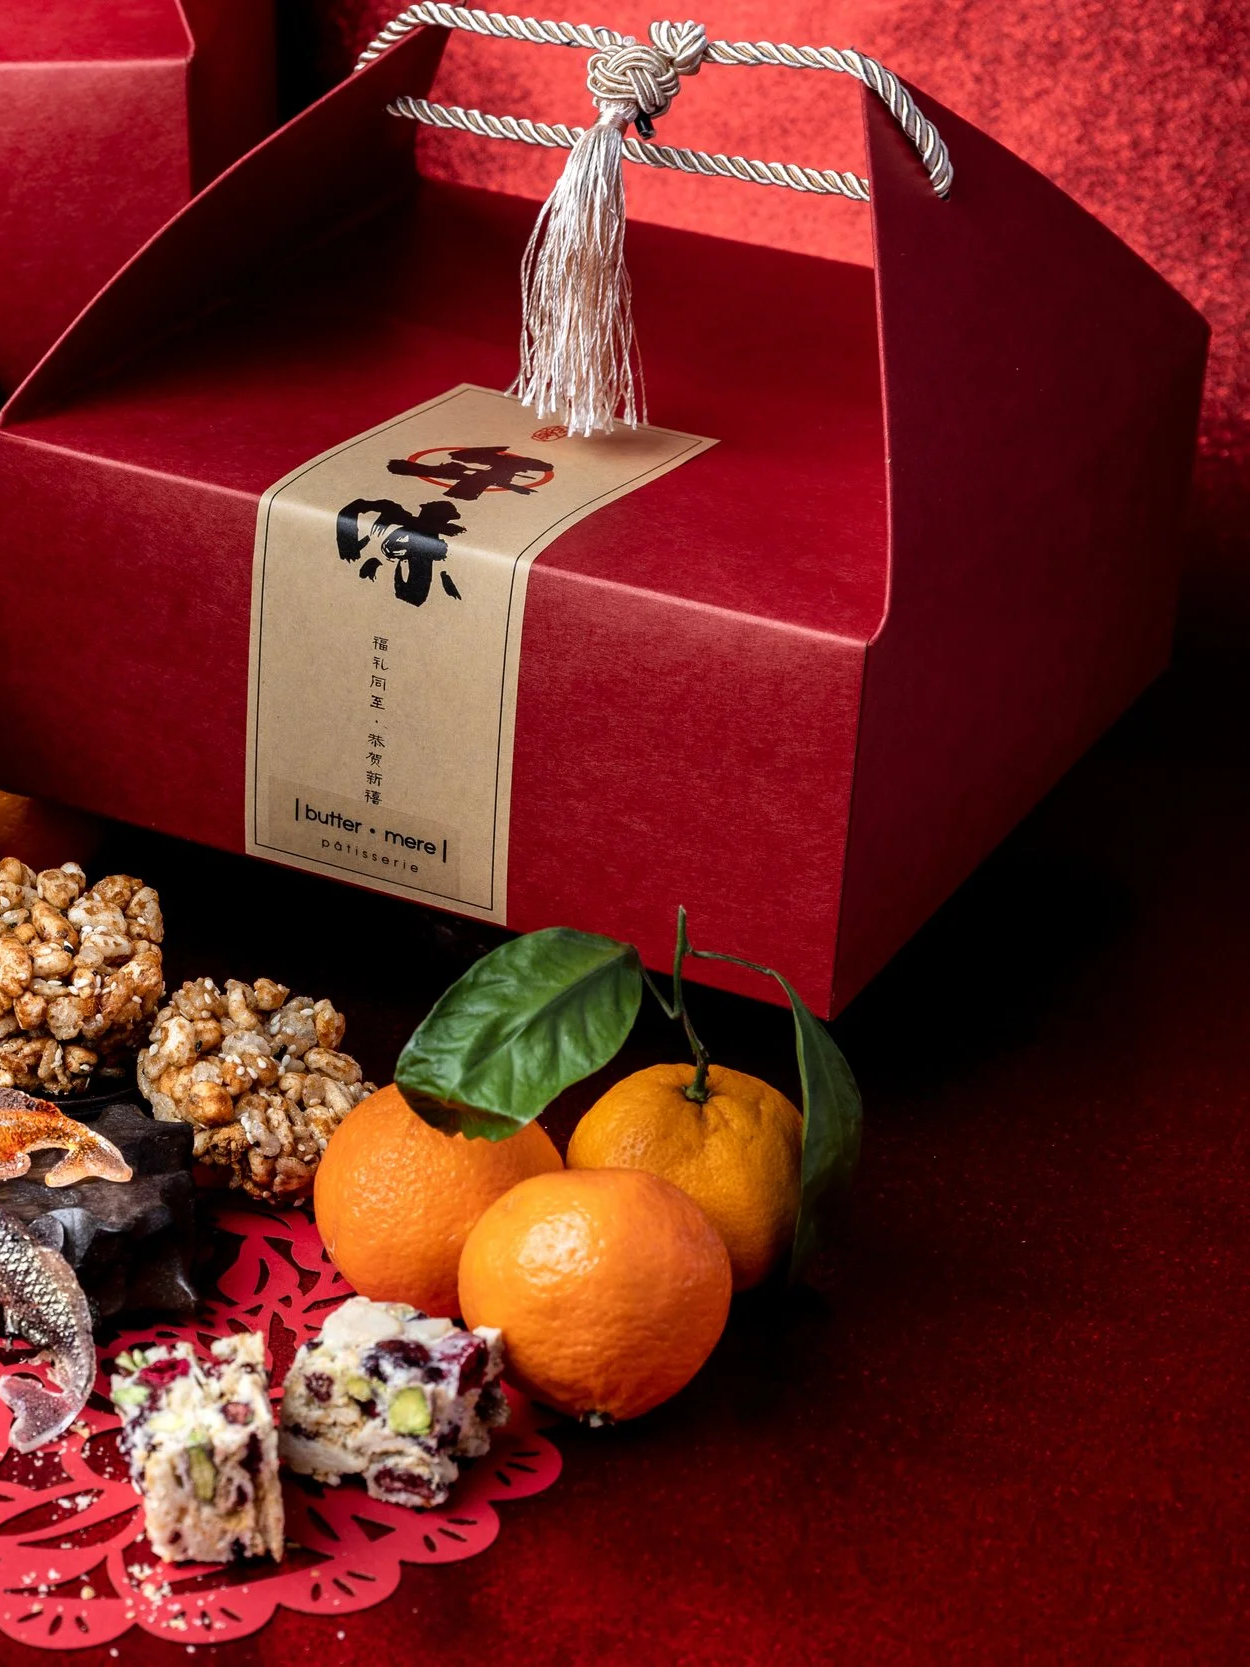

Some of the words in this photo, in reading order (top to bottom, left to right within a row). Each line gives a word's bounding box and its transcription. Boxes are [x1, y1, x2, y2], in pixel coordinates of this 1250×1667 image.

[305, 804, 363, 834] butter
[384, 830, 437, 855] mere
[321, 838, 419, 873] pâtisserie
